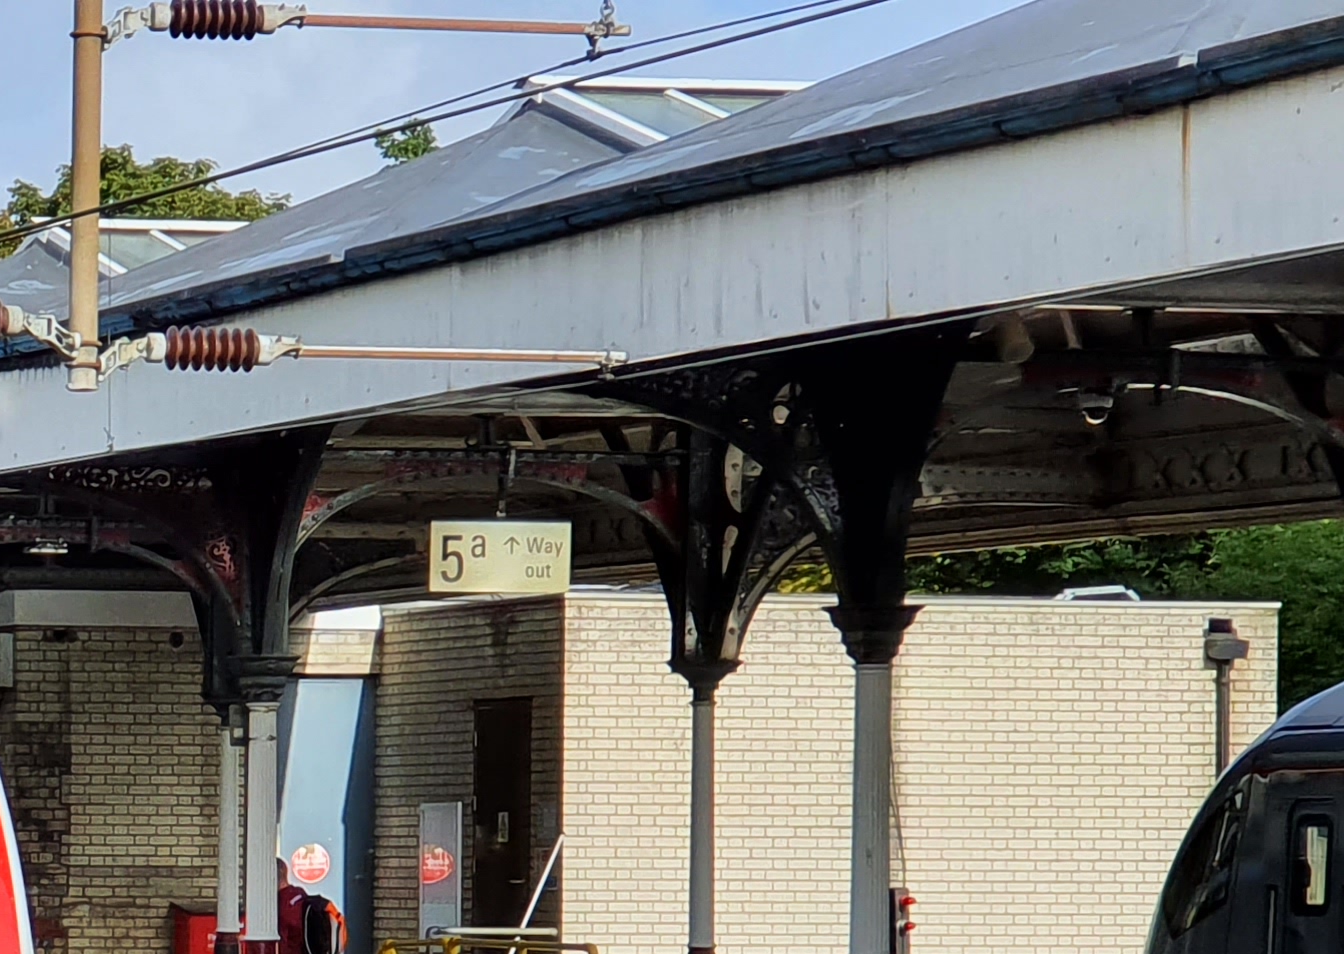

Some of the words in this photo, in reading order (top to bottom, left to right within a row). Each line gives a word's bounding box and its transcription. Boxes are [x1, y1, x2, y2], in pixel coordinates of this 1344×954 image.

[526, 536, 563, 558] Way
[440, 534, 486, 583] 5a
[525, 564, 552, 579] out
